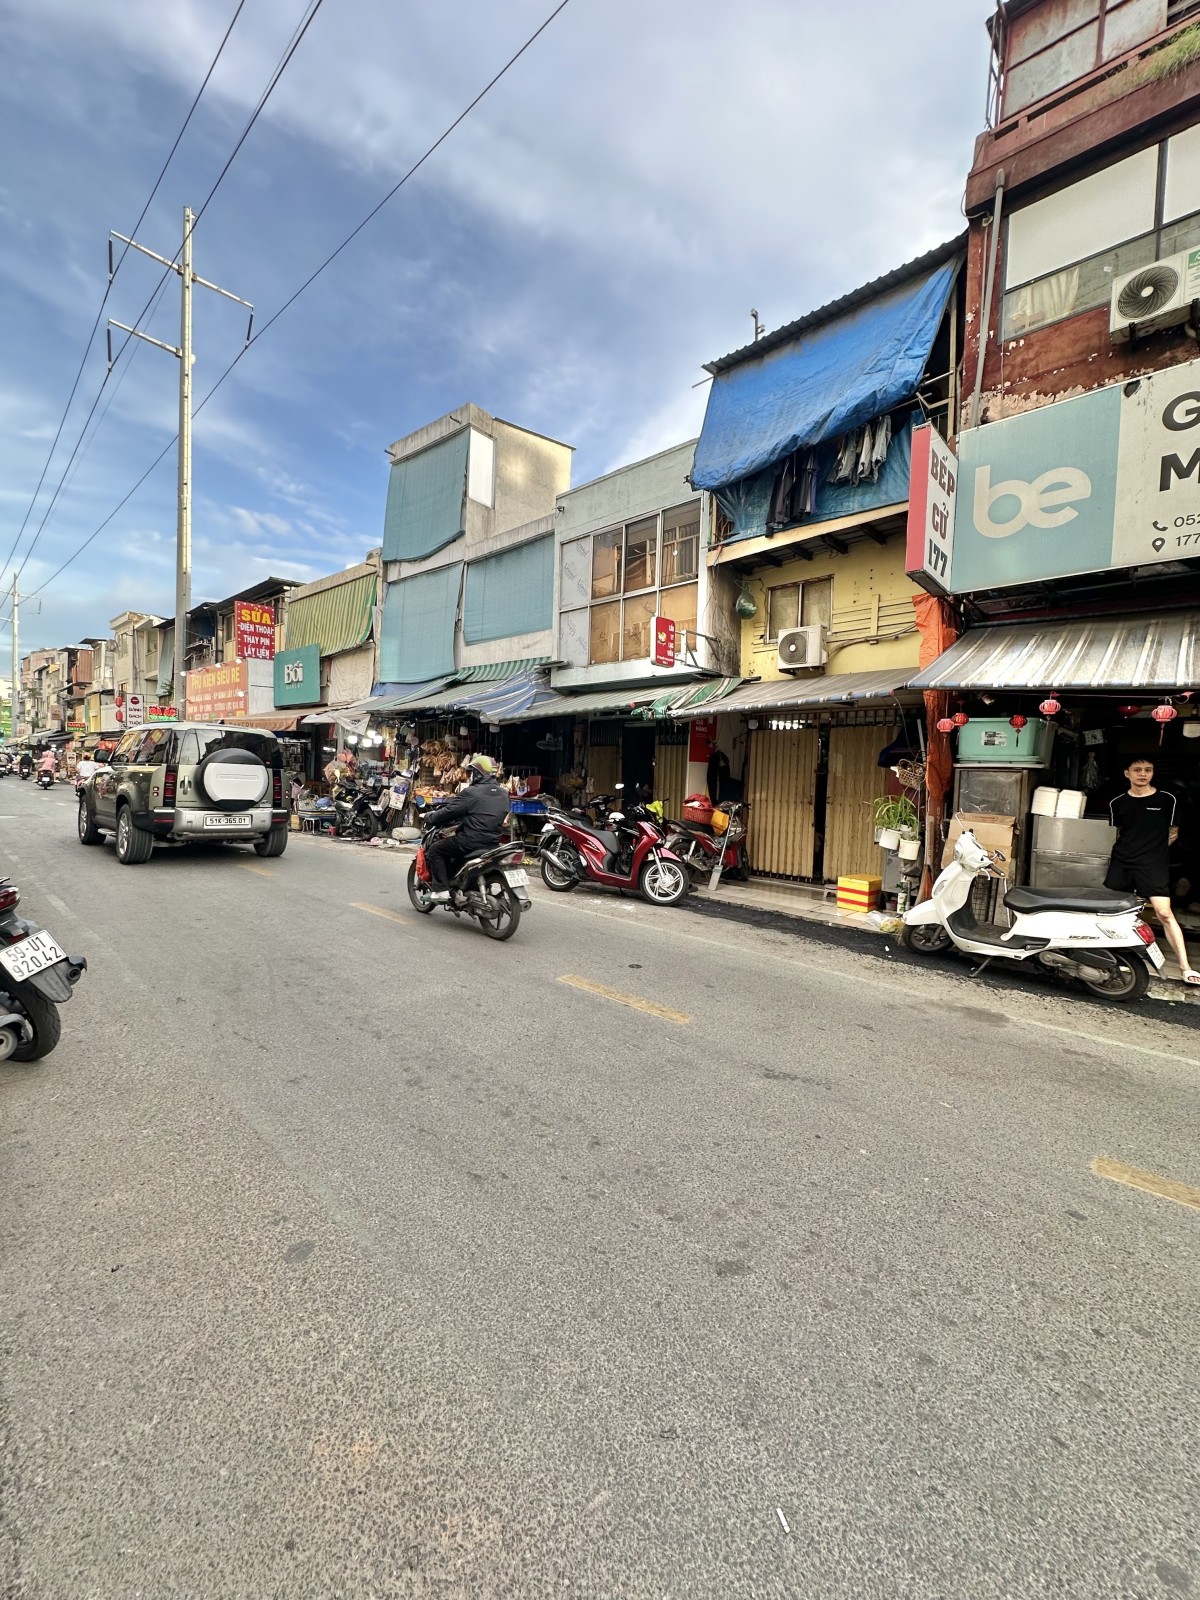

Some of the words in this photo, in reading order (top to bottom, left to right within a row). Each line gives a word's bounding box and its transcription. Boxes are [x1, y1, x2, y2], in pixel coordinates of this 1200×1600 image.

[930, 447, 956, 497] BẾP
[973, 464, 1092, 538] be
[928, 538, 948, 578] 177
[240, 622, 255, 634] ĐIỆN
[241, 607, 271, 624] SỬA
[243, 635, 259, 645] THAY
[260, 637, 270, 646] PIN
[5, 936, 46, 962] 59-U1
[12, 946, 62, 977] 920.42
